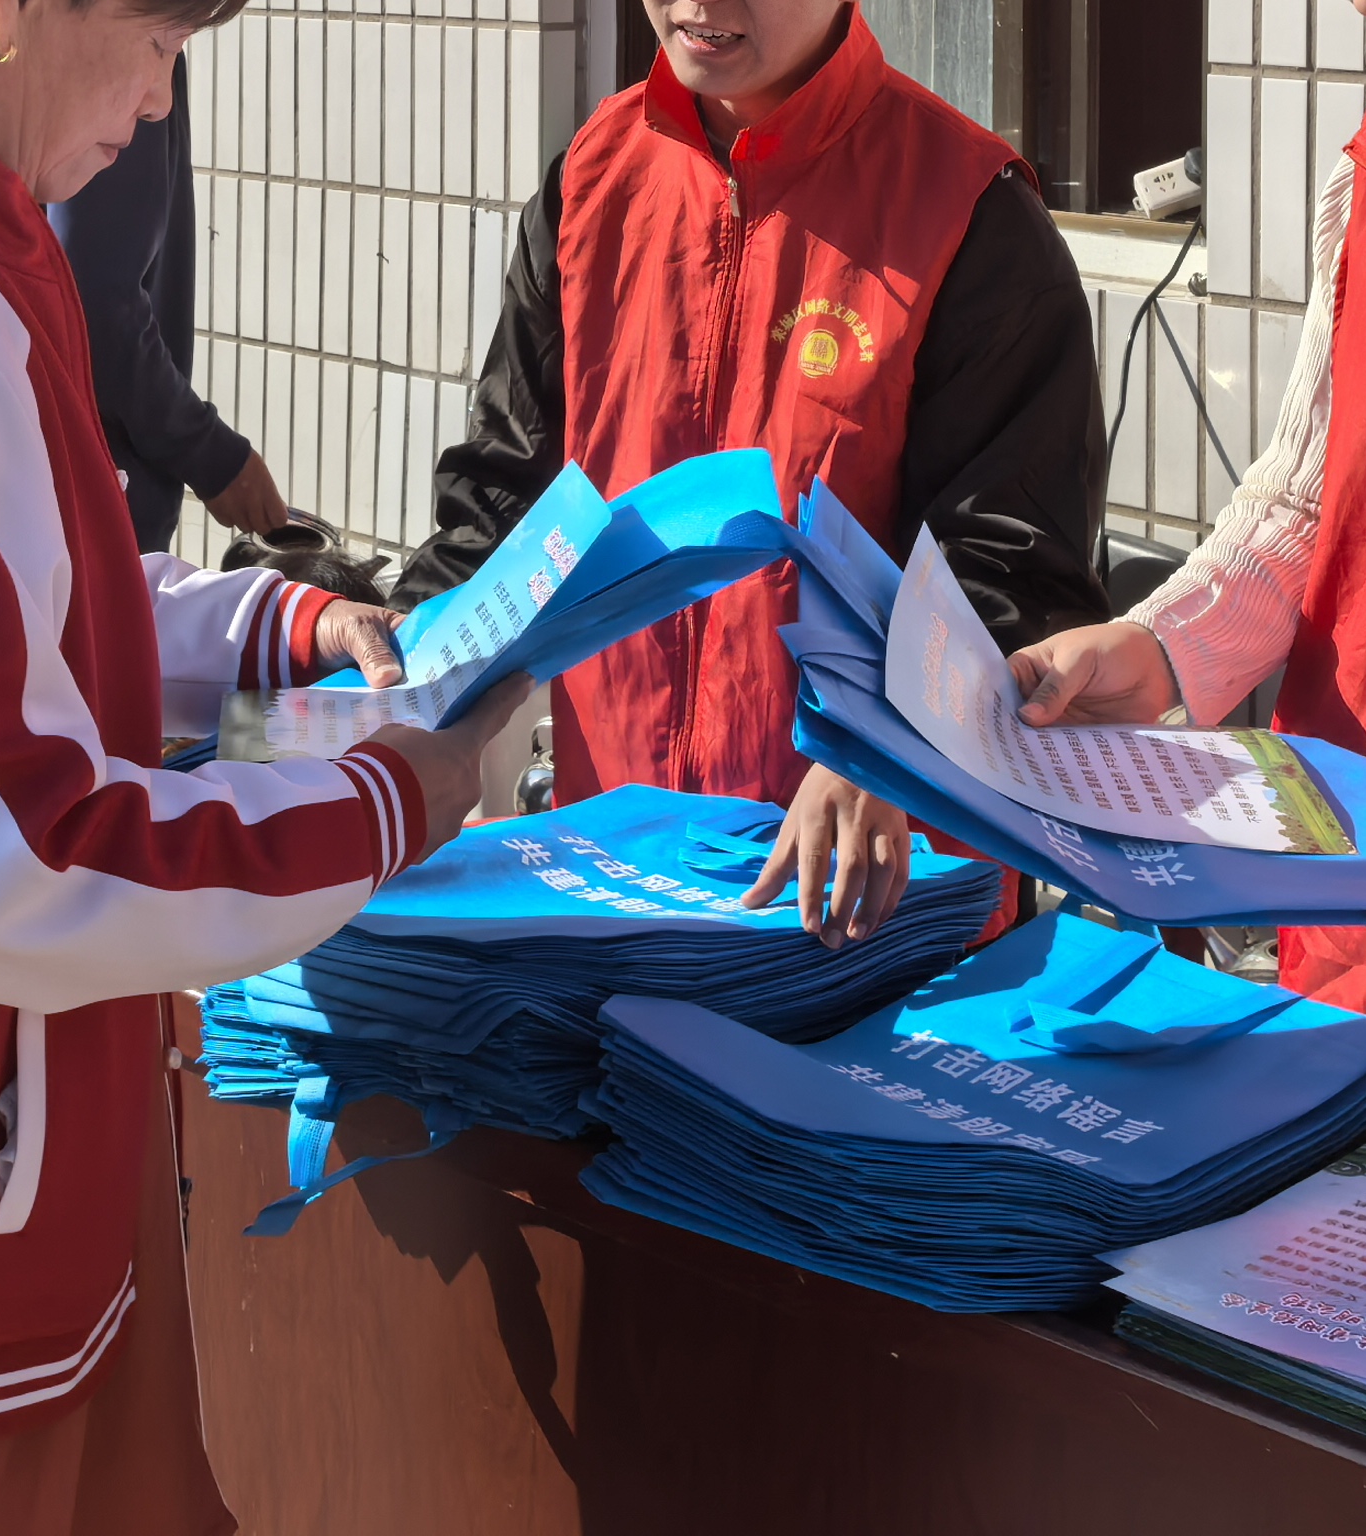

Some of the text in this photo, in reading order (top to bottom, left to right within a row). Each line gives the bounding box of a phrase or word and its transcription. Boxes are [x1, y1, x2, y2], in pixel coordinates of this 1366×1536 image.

[771, 298, 874, 362] 栾城区网络文明志愿者
[890, 1029, 1164, 1144] 打击网络谣言
